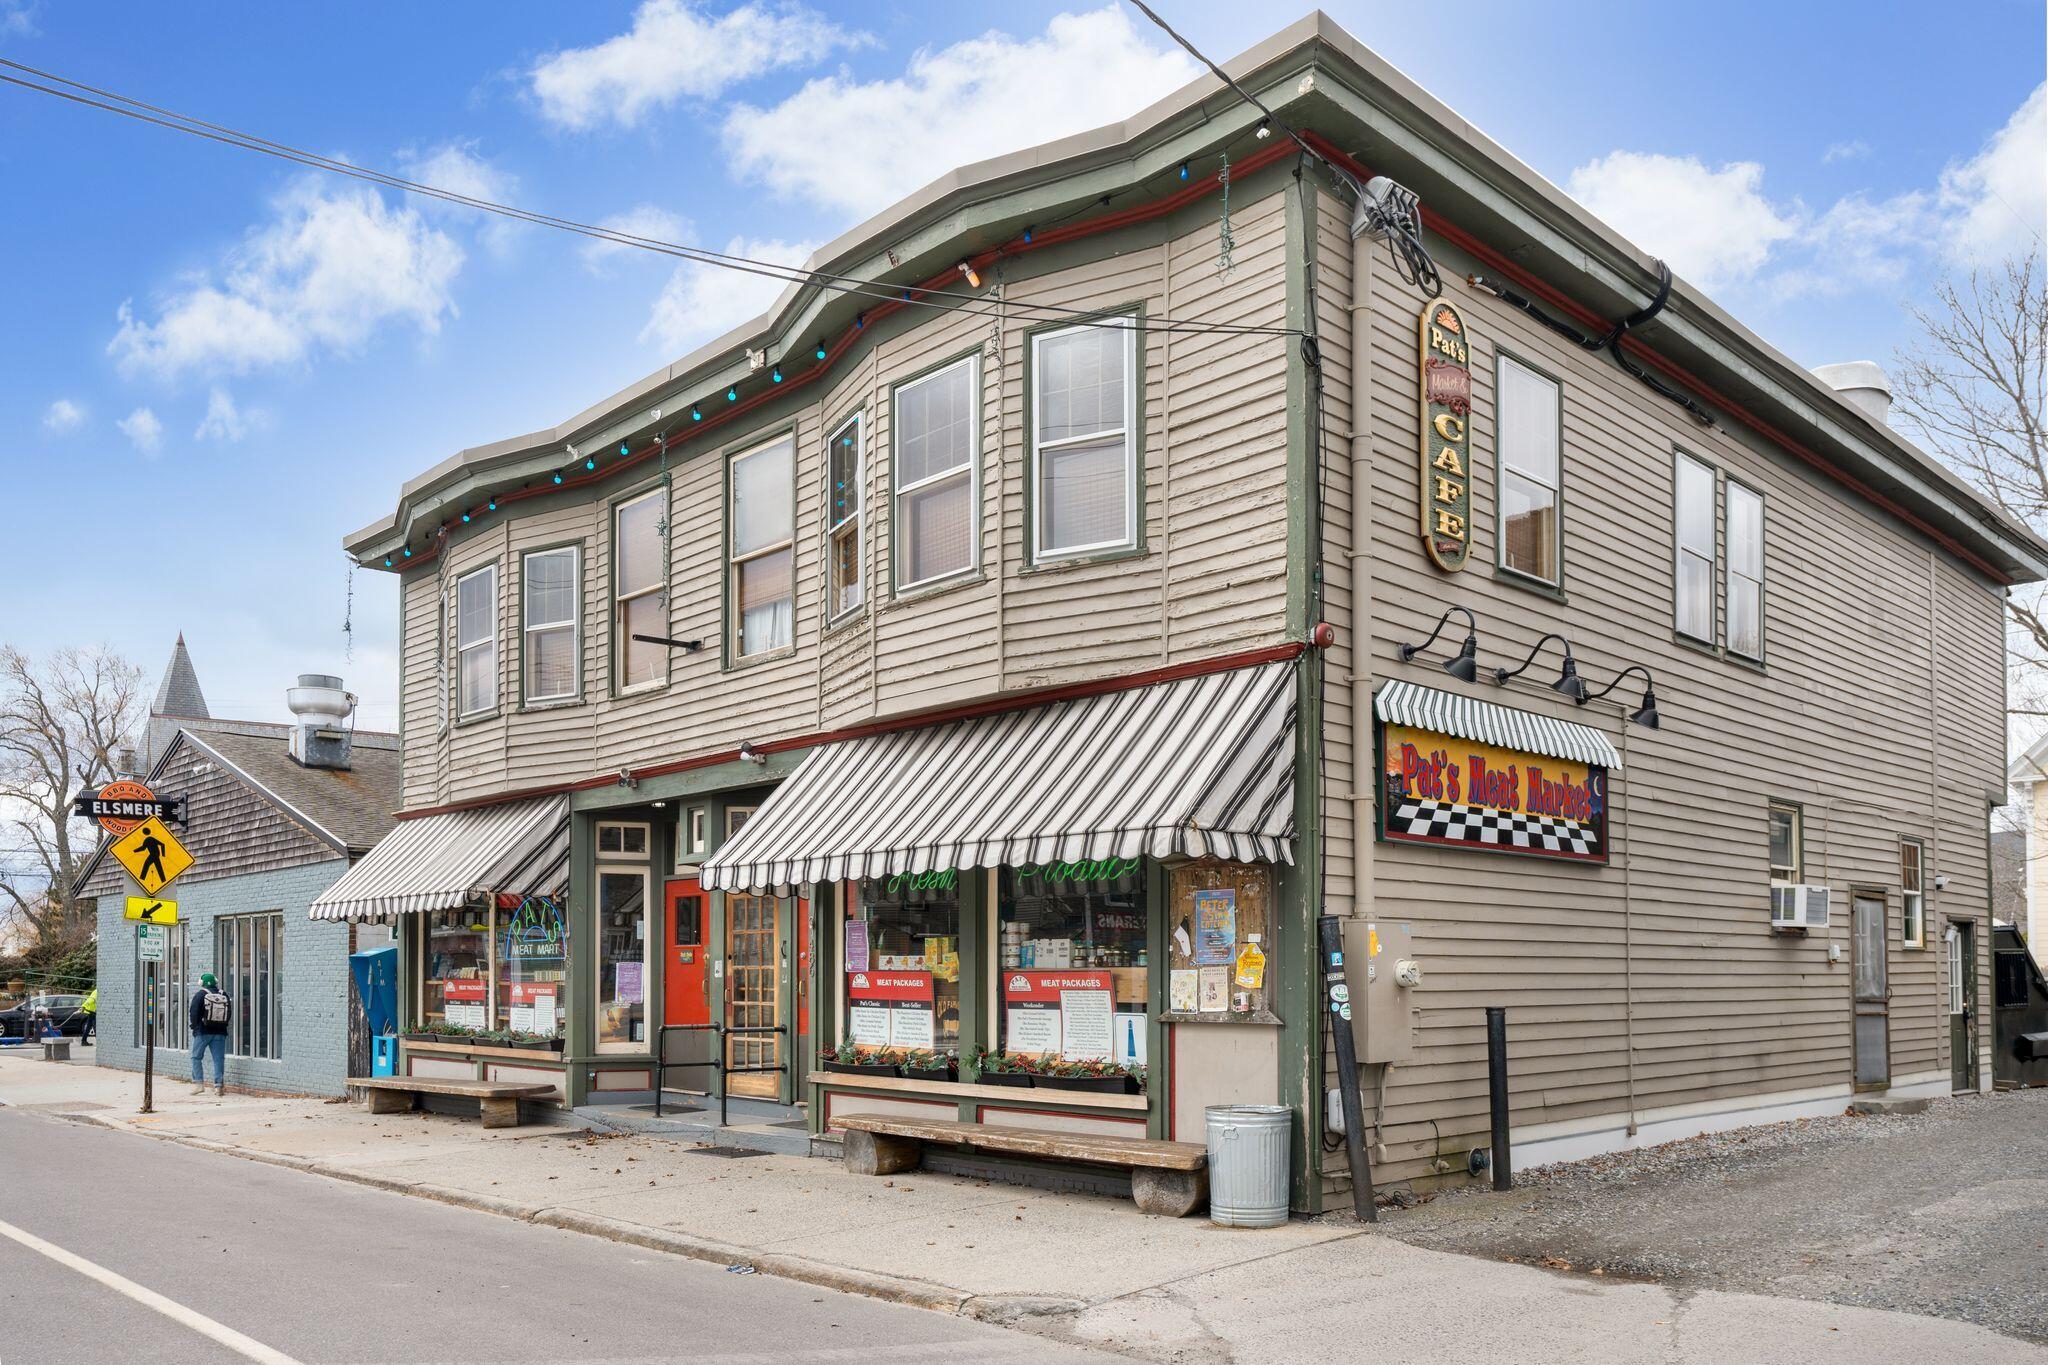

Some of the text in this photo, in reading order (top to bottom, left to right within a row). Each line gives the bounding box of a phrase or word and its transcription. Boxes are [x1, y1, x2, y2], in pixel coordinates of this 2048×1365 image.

[1432, 327, 1466, 363] Pat's
[1432, 373, 1468, 393] Market &
[1433, 413, 1465, 542] CAFE
[1401, 743, 1592, 822] Pat's Meat Market
[107, 786, 147, 798] BBQ AND
[92, 801, 163, 817] ELSMERE
[106, 819, 127, 832] WOOD
[140, 927, 147, 935] 15
[512, 943, 560, 956] MEAT MART
[893, 979, 924, 987] PACKAGES
[1041, 979, 1101, 987] MEAT PACKAGES
